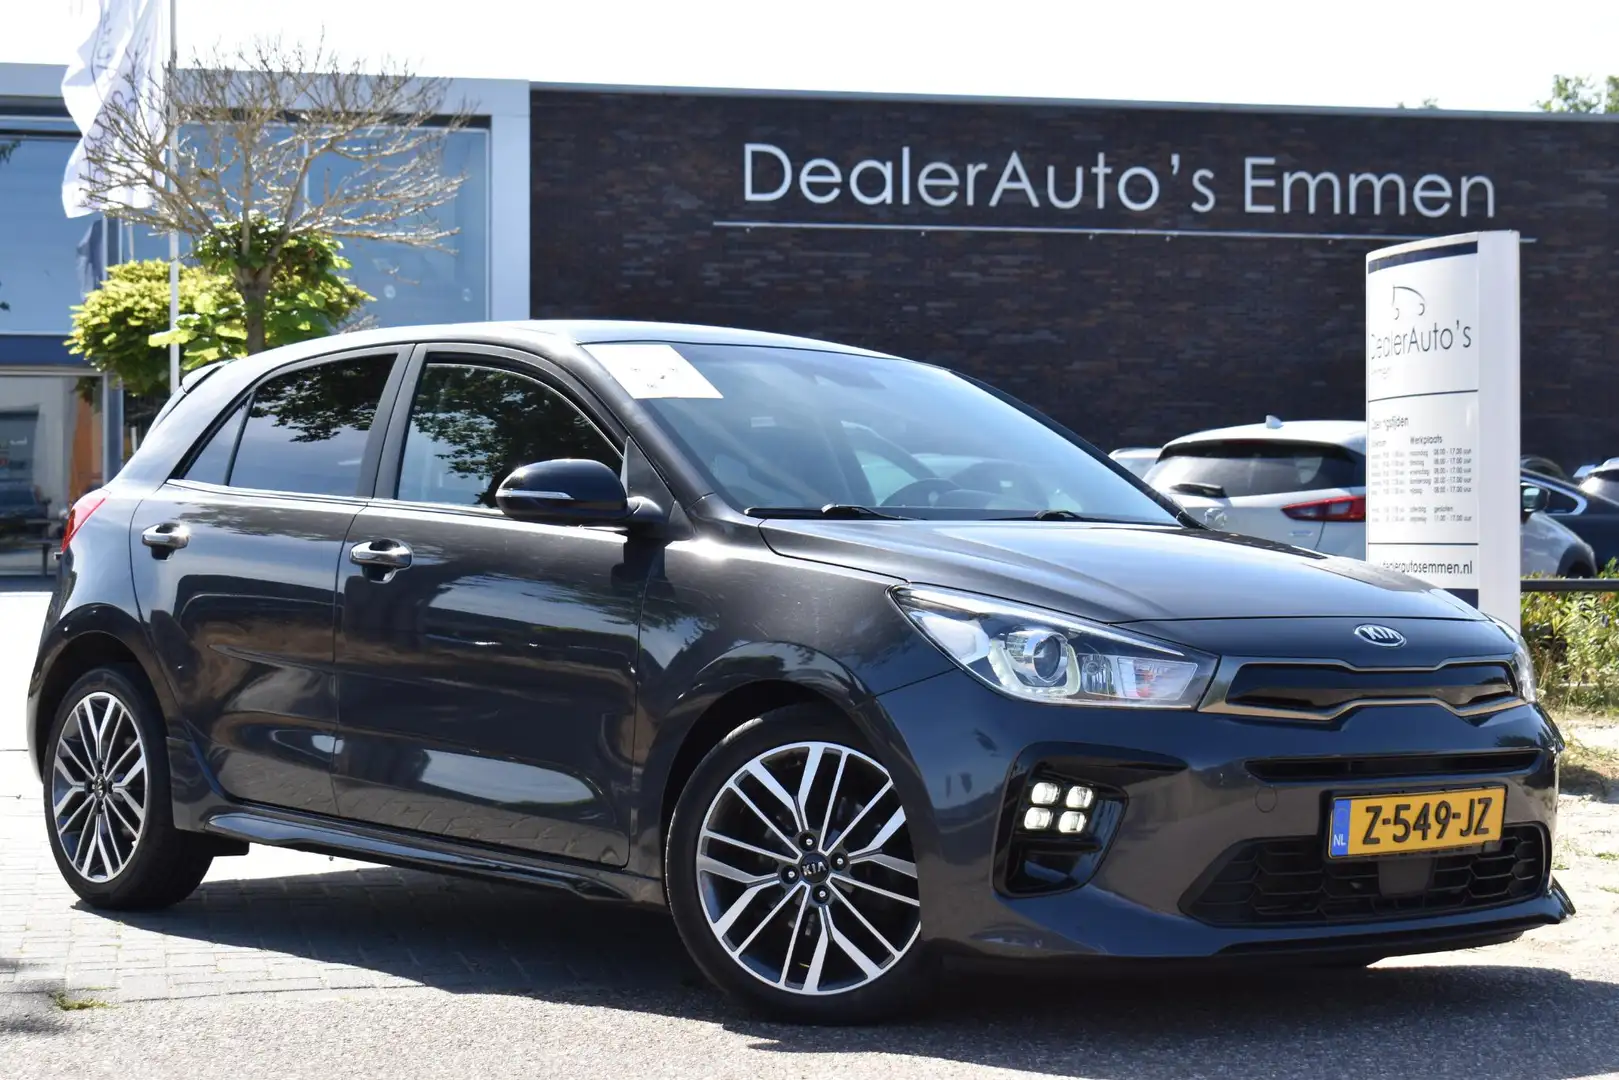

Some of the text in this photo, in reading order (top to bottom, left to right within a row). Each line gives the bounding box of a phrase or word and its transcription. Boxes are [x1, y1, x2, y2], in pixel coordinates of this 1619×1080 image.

[743, 142, 1496, 219] DealerAuto's Emmen
[1364, 625, 1401, 642] KIA
[1362, 797, 1492, 845] Z-549-JZ
[1333, 833, 1346, 847] NL
[802, 861, 827, 876] KIA
